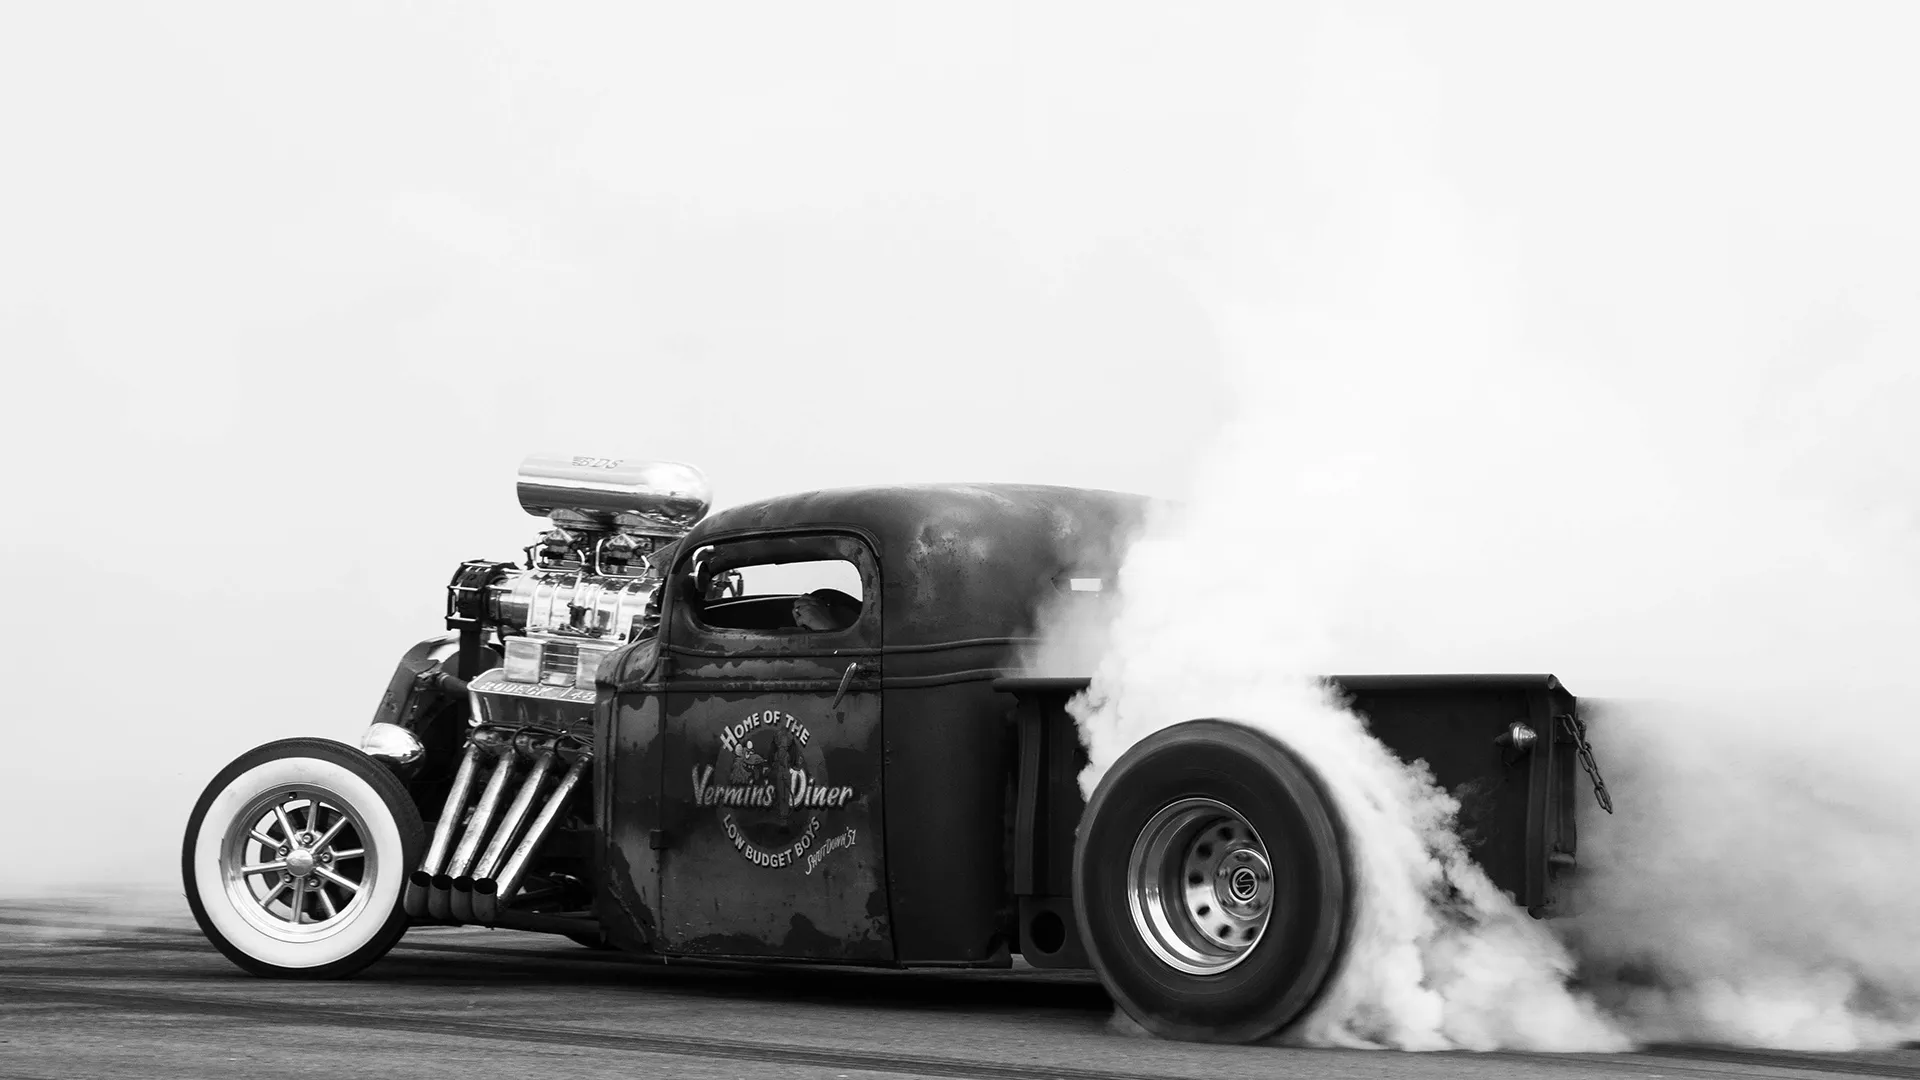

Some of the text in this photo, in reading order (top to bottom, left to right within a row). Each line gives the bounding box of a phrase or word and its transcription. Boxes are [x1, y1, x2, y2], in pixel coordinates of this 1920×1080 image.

[720, 710, 811, 752] HOME OF THE
[692, 764, 853, 807] Vermin's Diner
[723, 814, 820, 867] LOW BUDGET BOYS
